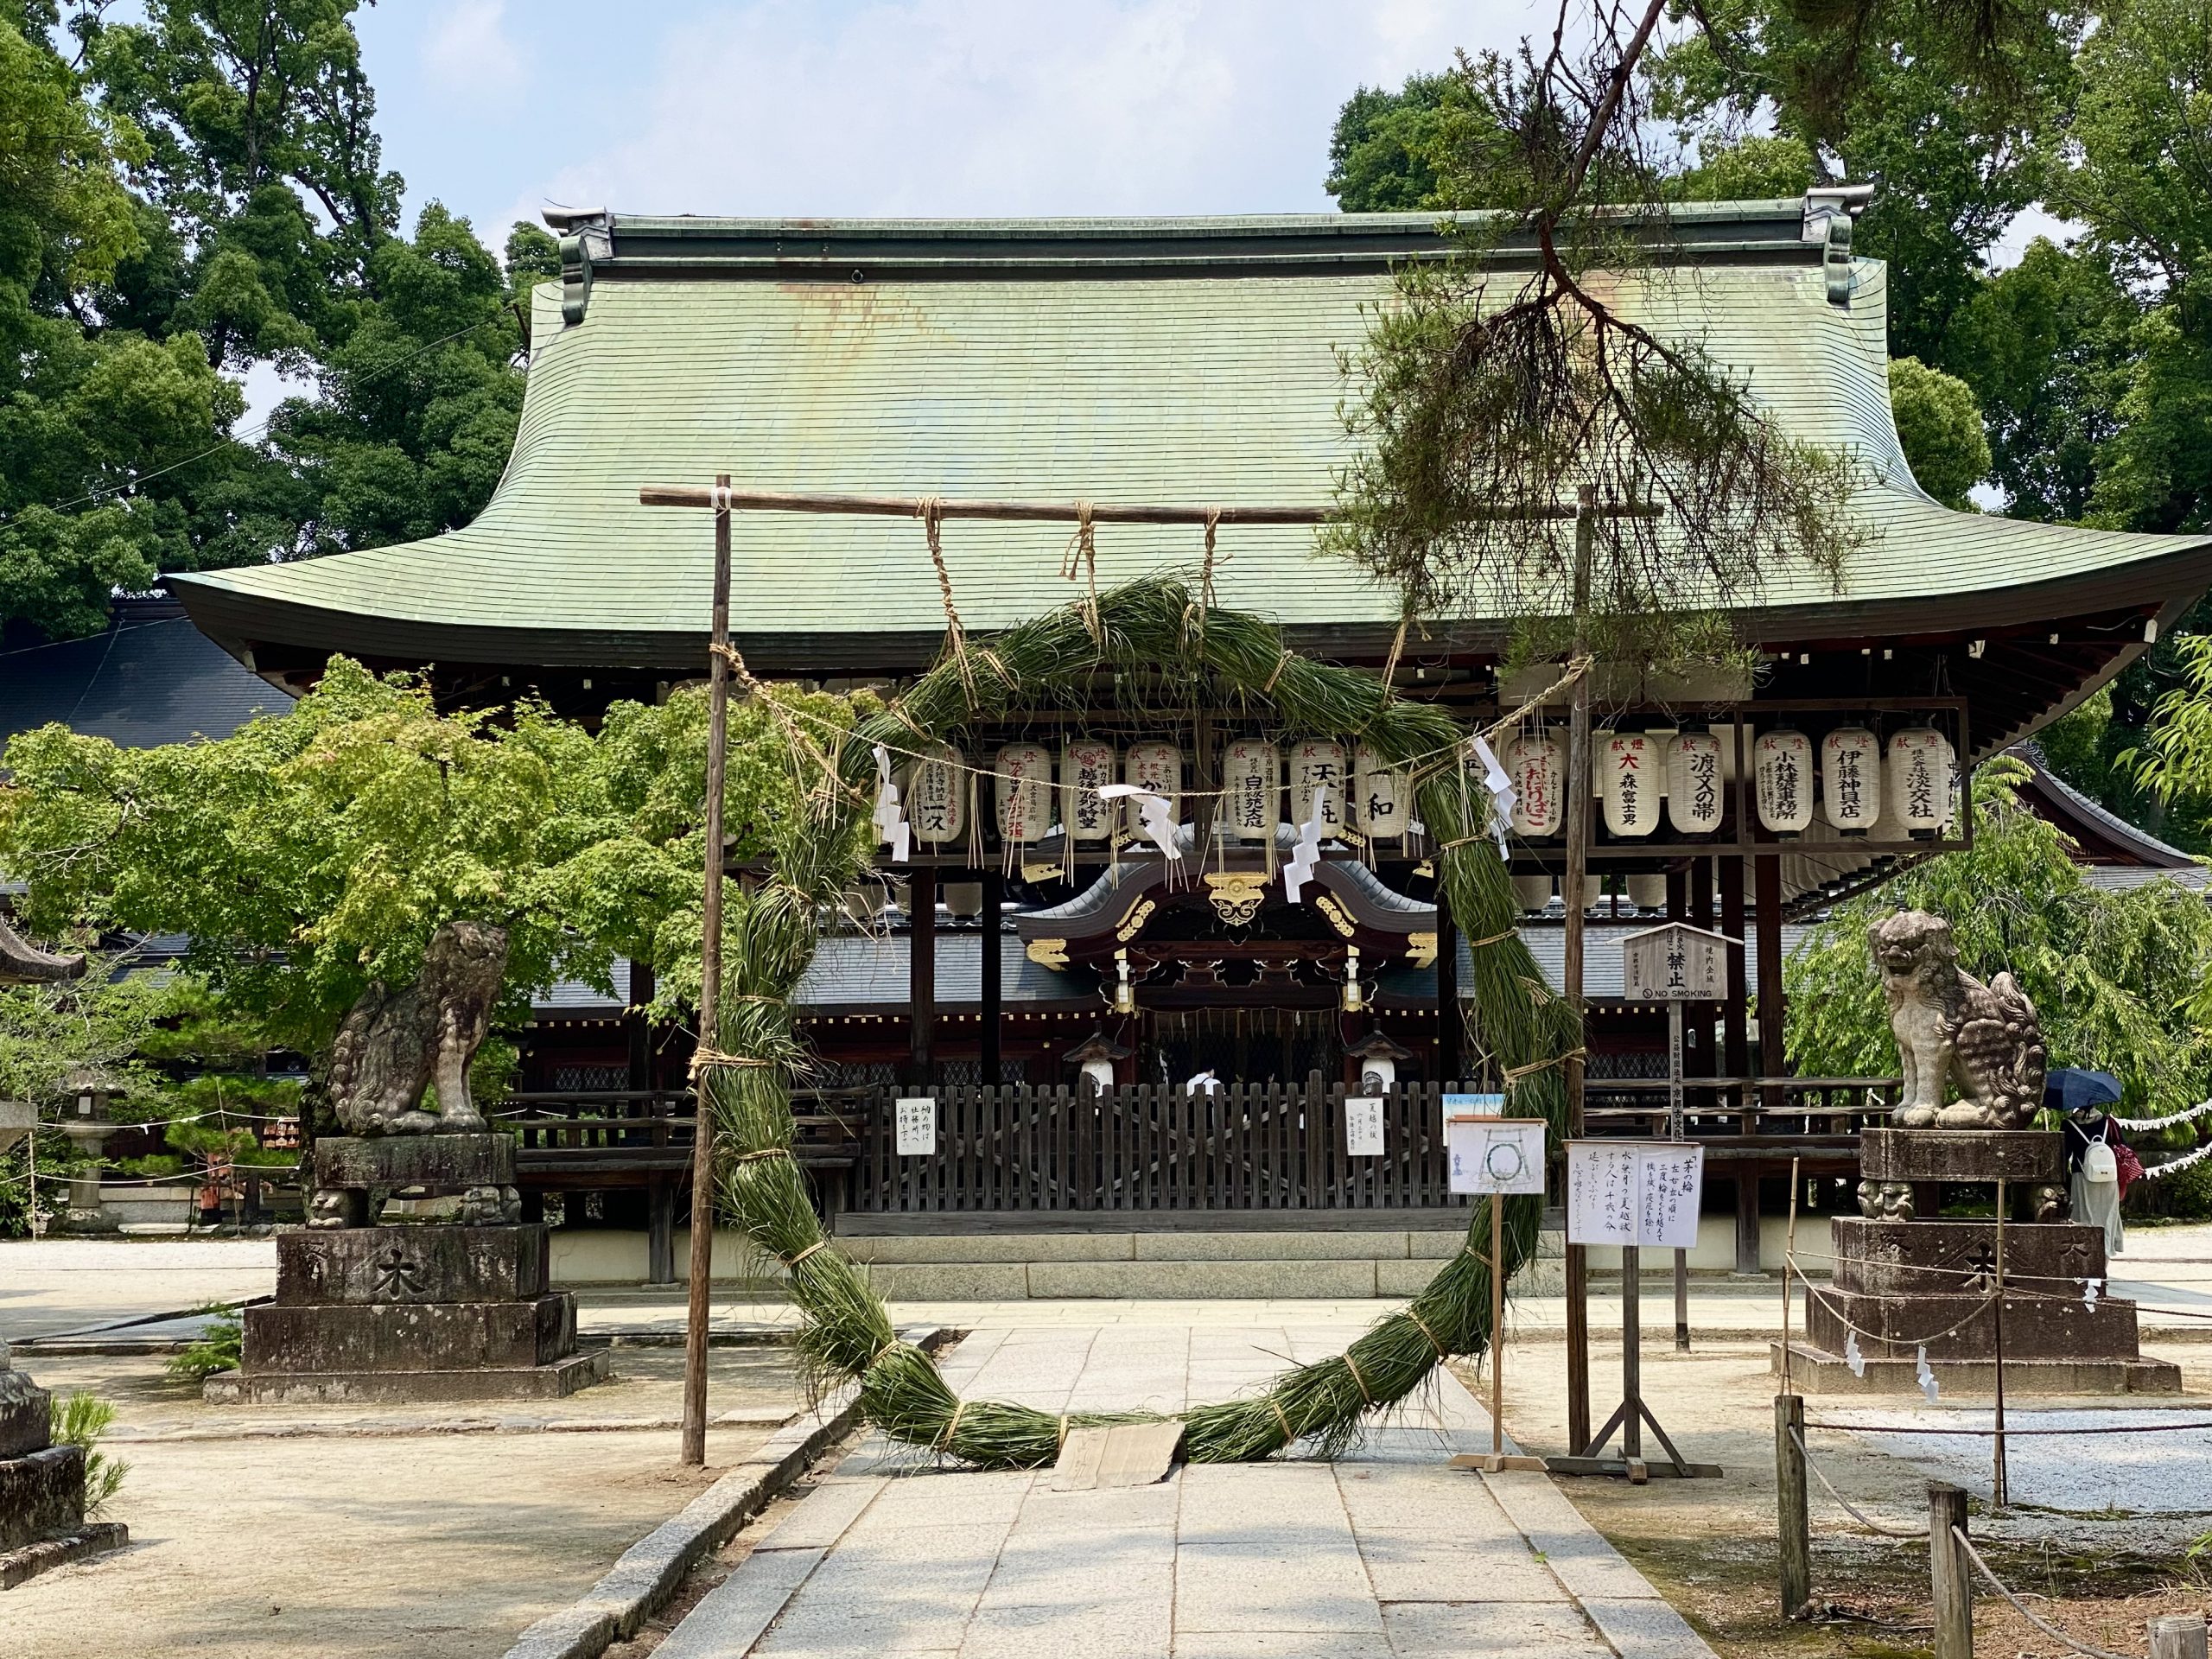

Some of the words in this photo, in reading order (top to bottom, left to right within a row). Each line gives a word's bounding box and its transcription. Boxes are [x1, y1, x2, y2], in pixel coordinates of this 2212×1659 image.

[1690, 753, 1715, 822] 渡文の帯
[1775, 751, 1798, 820] 小林建築事務所
[1836, 750, 1863, 818] 伊藤神具店
[1906, 772, 1935, 818] 淡交社
[1667, 952, 1686, 988] 禁止
[1706, 946, 1714, 983] 境内全域
[1673, 1088, 1682, 1143] 京都古文化
